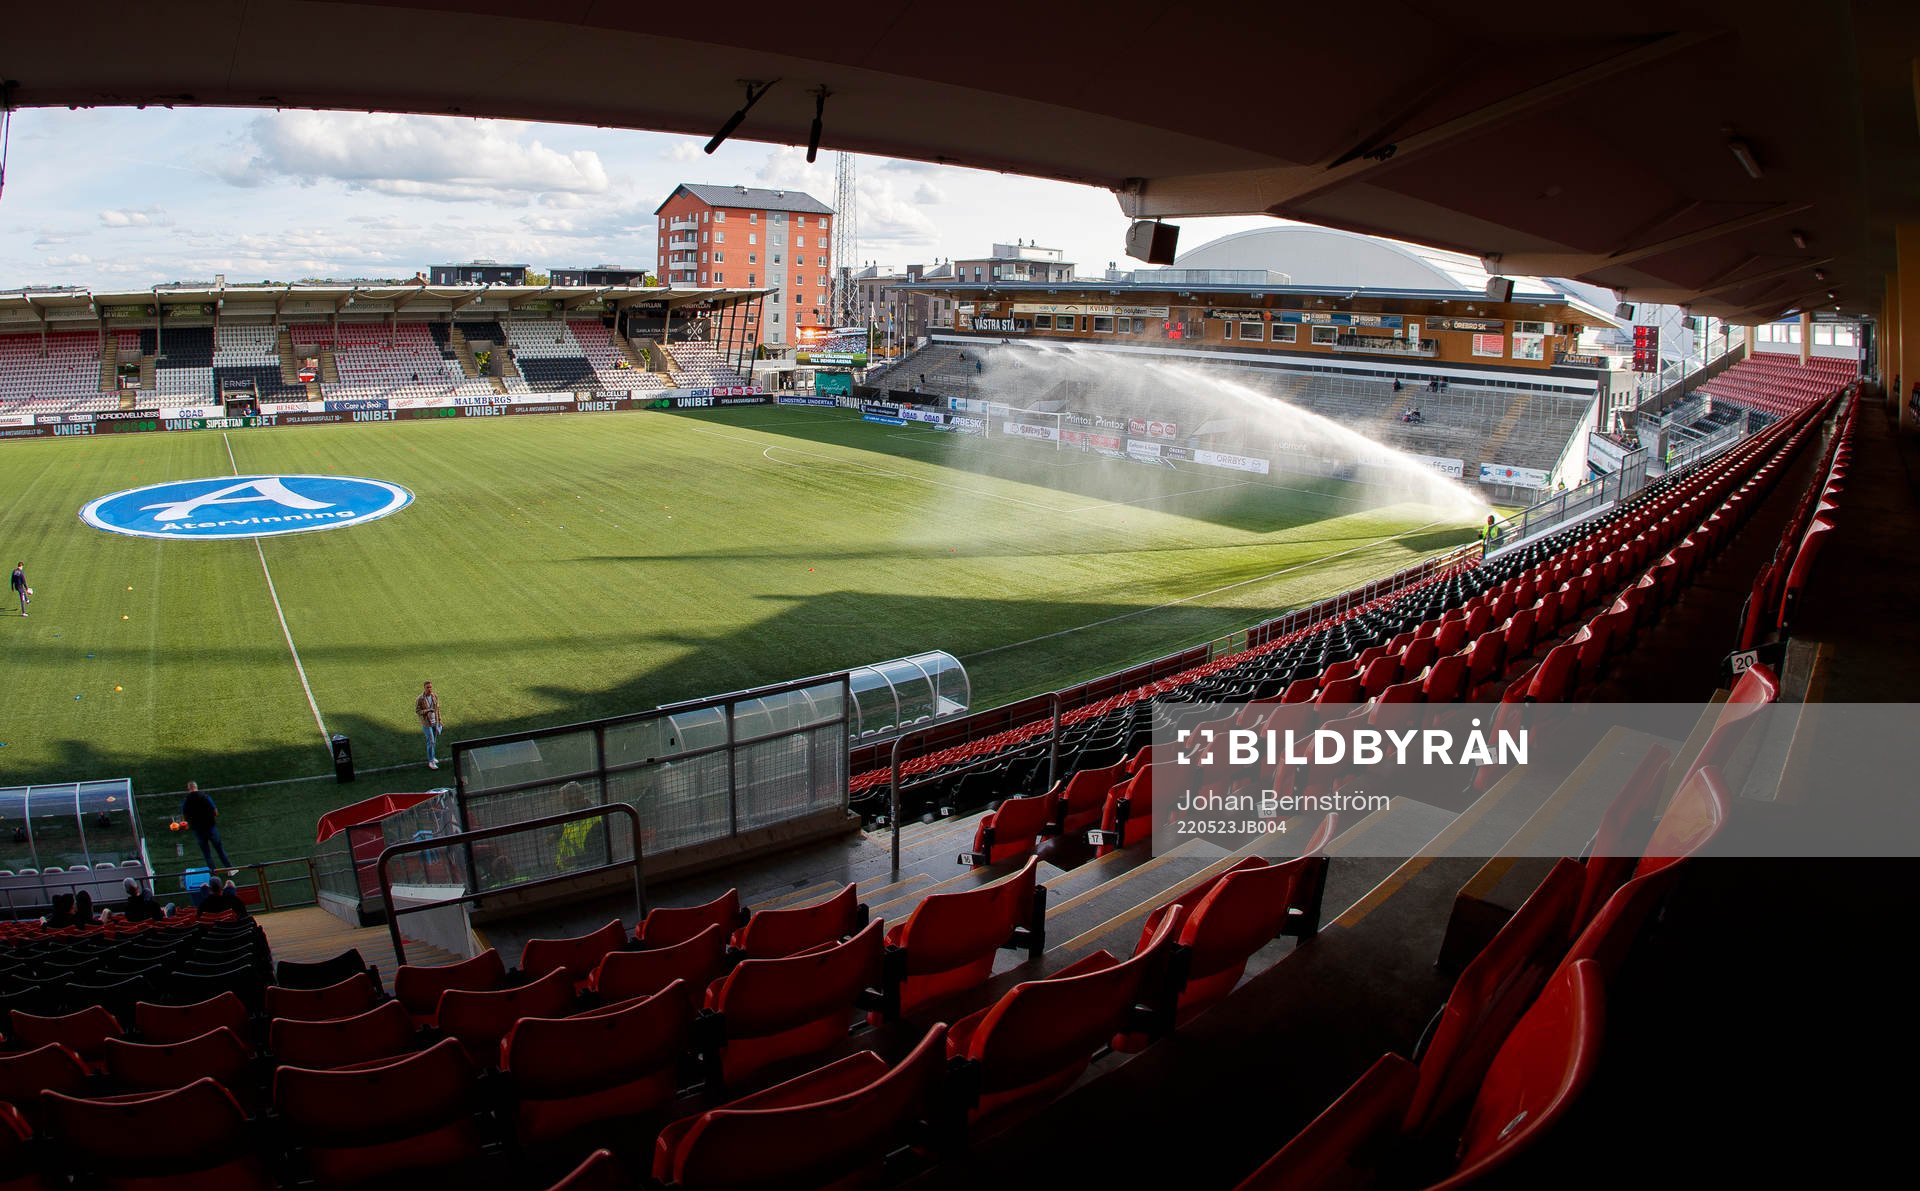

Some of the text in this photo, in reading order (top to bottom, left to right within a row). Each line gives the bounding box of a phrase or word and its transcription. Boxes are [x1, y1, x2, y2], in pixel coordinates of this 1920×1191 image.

[974, 317, 1000, 330] VÄSTRA
[224, 380, 252, 388] ERNST
[455, 396, 512, 405] MALMBERGS
[577, 401, 618, 411] UNIBET
[678, 397, 715, 408] UNIBET
[353, 410, 397, 421] UNIBET
[465, 405, 507, 416] UNIBET
[206, 418, 243, 428] SUPERETTAN
[53, 424, 96, 436] UNIBET
[160, 509, 356, 531] Återvinning
[1736, 655, 1754, 670] 20
